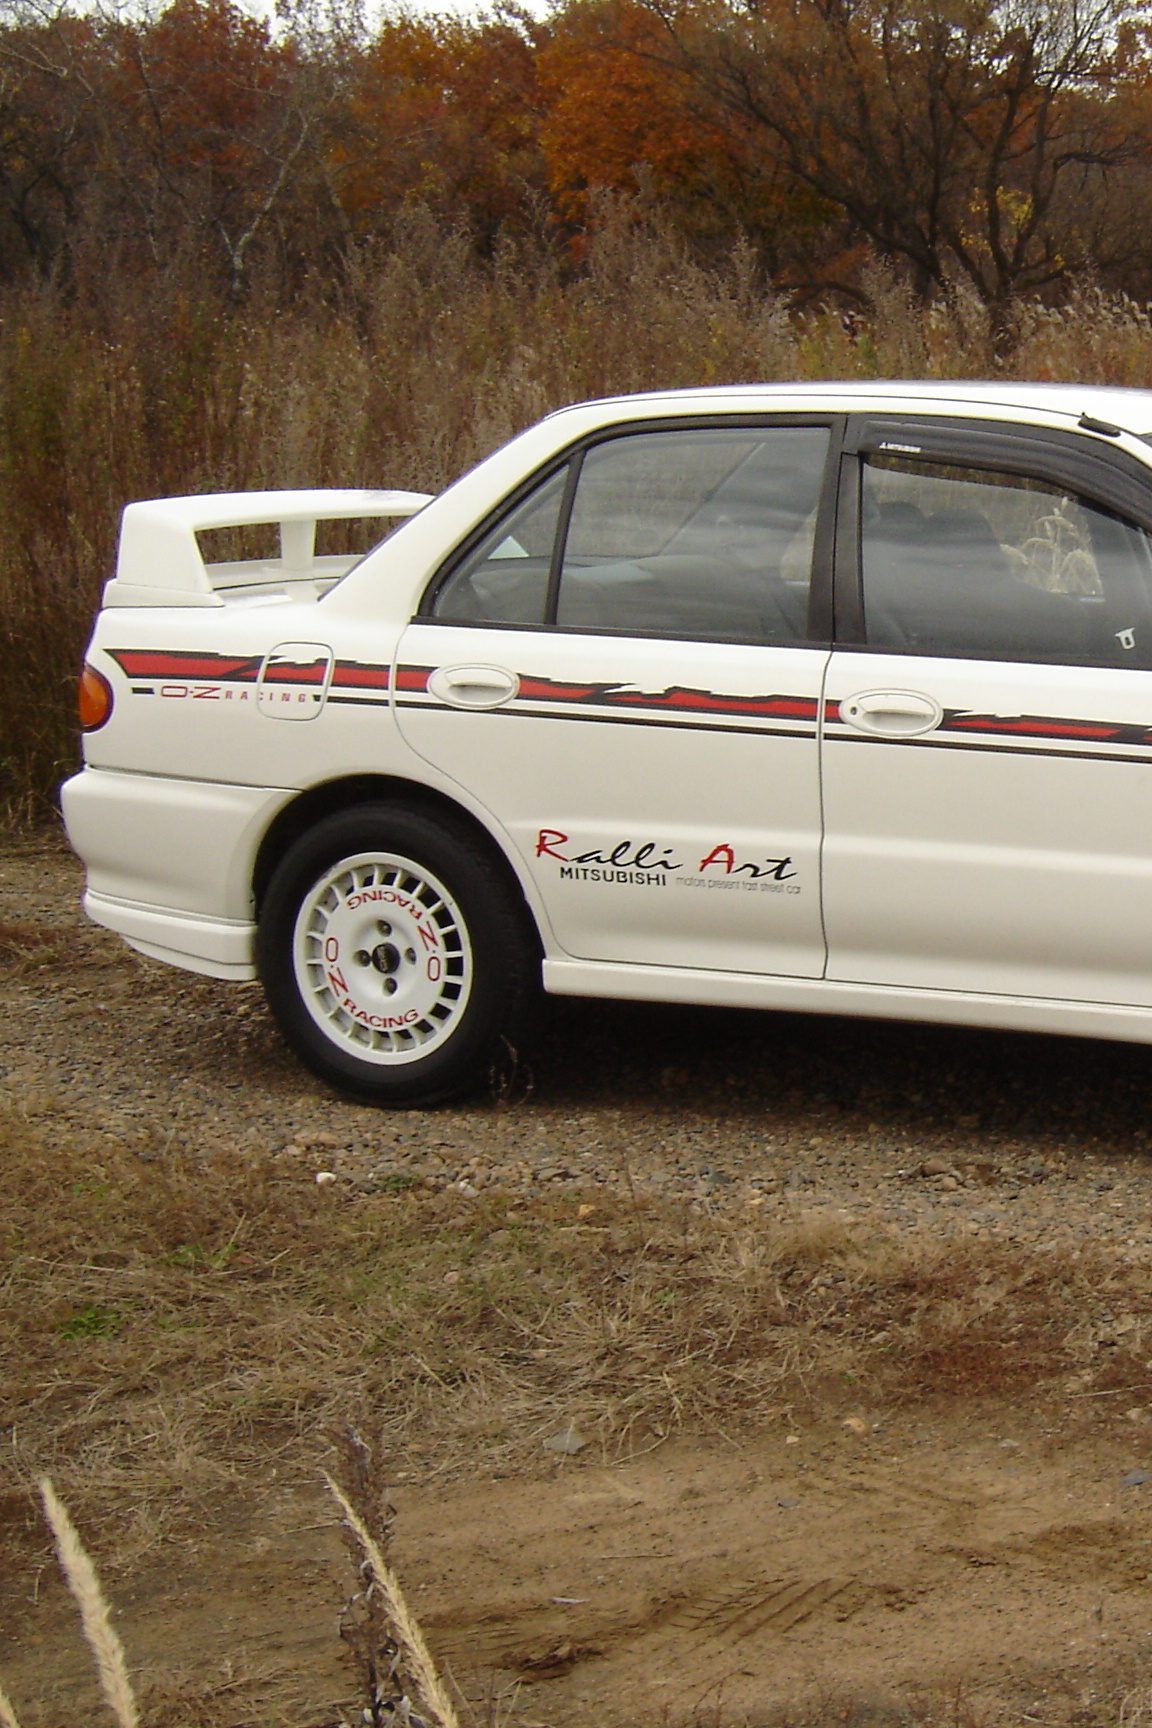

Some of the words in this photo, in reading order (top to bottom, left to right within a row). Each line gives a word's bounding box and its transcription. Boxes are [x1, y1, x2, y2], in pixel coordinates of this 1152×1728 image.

[536, 829, 683, 870] Ralli
[698, 843, 798, 881] Art
[560, 867, 667, 886] MITSUBISHI
[346, 889, 423, 920] RACING
[343, 999, 419, 1028] RACING
